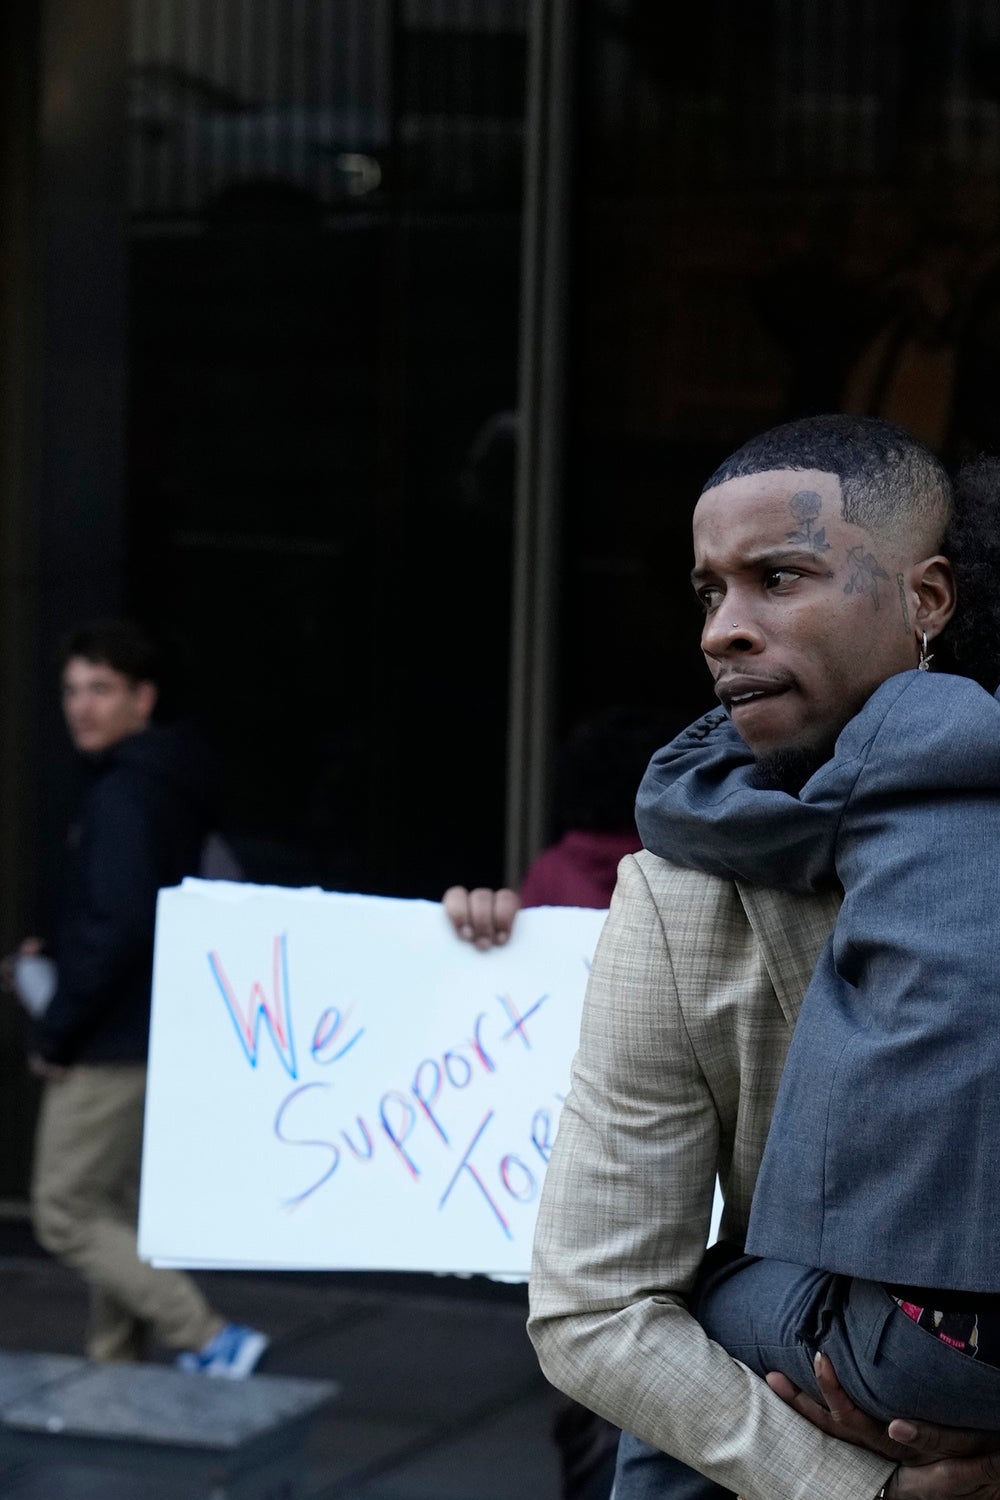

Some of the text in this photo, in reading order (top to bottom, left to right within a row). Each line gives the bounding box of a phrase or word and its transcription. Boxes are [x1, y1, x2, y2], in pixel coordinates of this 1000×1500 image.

[208, 932, 365, 1080] We
[275, 994, 550, 1213] Support
[438, 1093, 566, 1241] TOR
